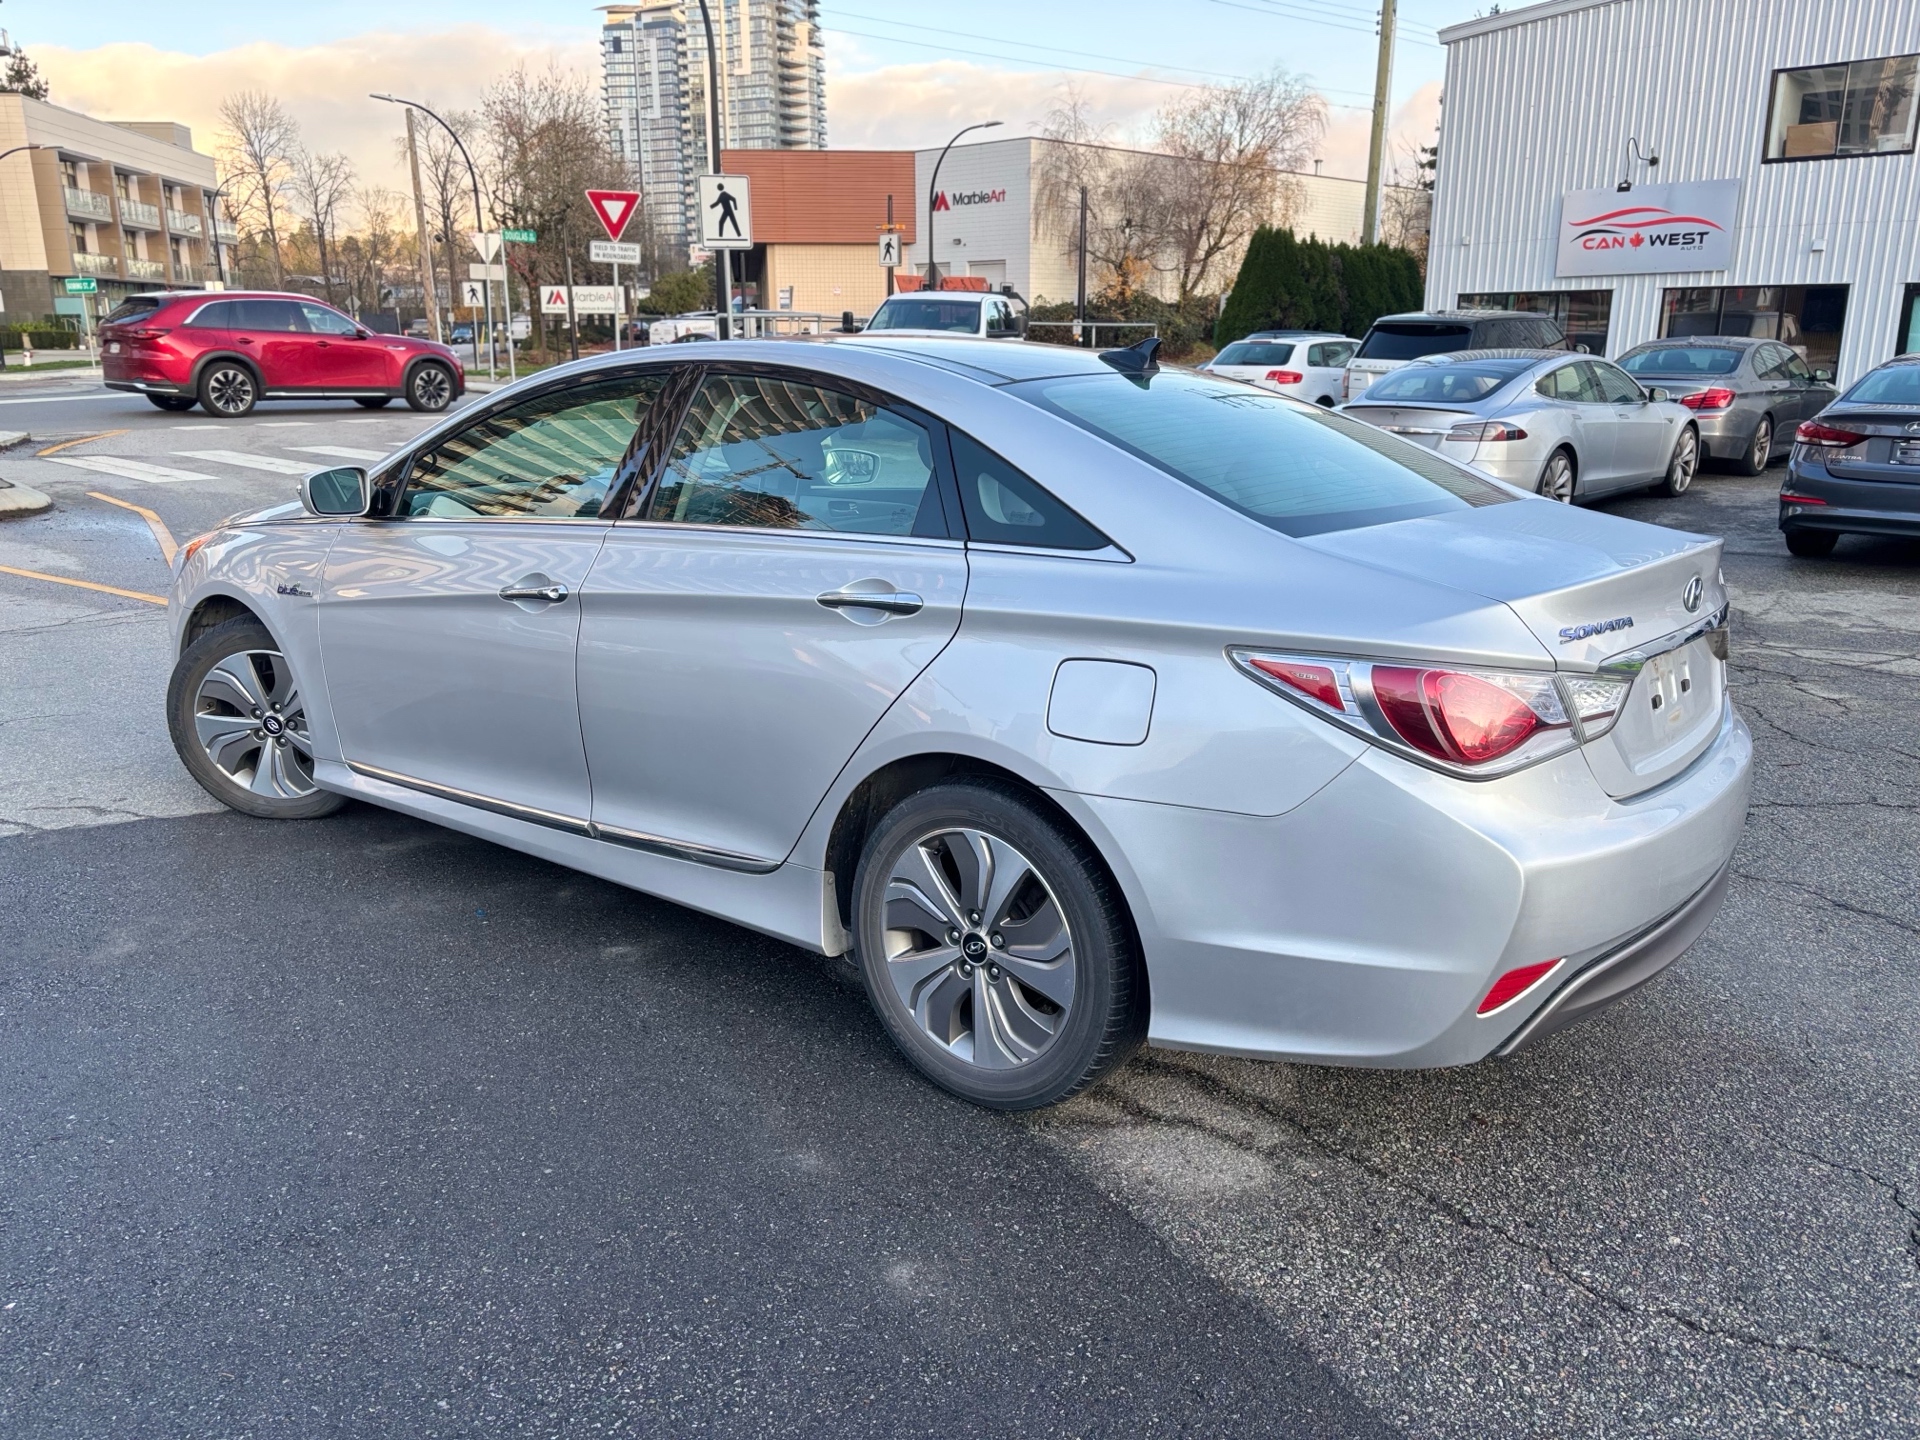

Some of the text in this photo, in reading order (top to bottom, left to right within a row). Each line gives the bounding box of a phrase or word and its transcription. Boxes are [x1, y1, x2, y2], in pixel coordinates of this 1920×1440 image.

[952, 188, 1006, 206] MarbleArt
[504, 230, 528, 241] DOUGLAS
[1582, 231, 1710, 250] CAN WEST
[617, 246, 637, 254] TRAFFIC
[602, 253, 637, 261] ROUNDABOUT
[1828, 453, 1862, 461] ELANTRA
[1559, 616, 1634, 645] SONATA
